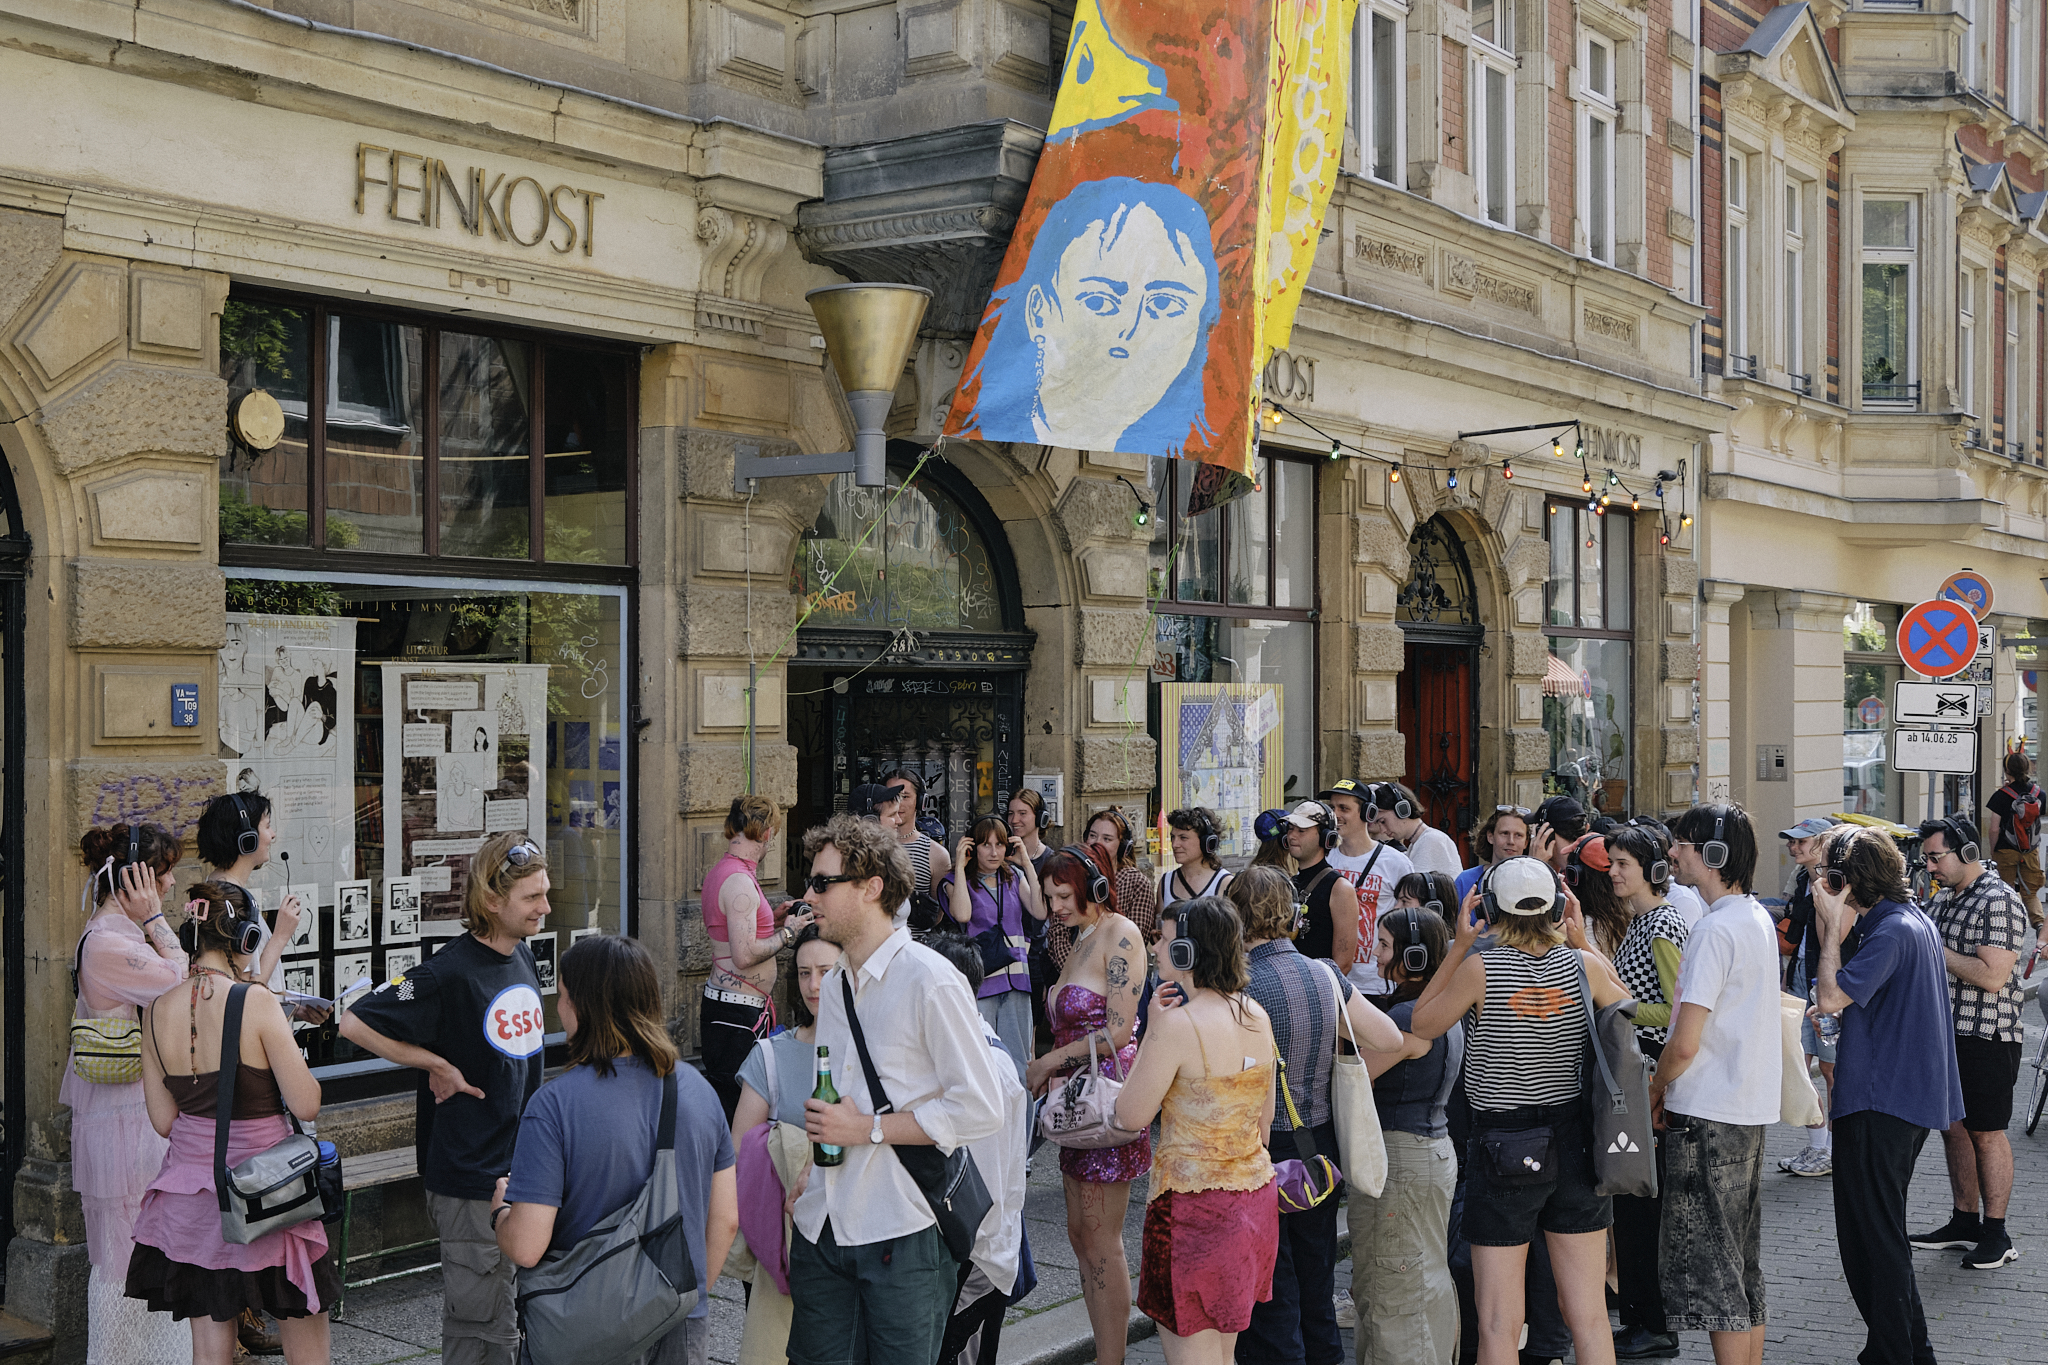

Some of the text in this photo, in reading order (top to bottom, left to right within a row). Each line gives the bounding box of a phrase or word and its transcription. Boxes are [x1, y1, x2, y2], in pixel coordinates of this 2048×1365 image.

[356, 142, 605, 257] FEINKOST
[248, 619, 329, 630] BUCHHANDLUNG
[406, 645, 449, 655] LITERATUR
[391, 656, 419, 666] KUNST
[183, 713, 194, 724] 38
[1907, 732, 1958, 744] ab 14.06.25
[1361, 892, 1375, 903] 63
[322, 1030, 330, 1040] G
